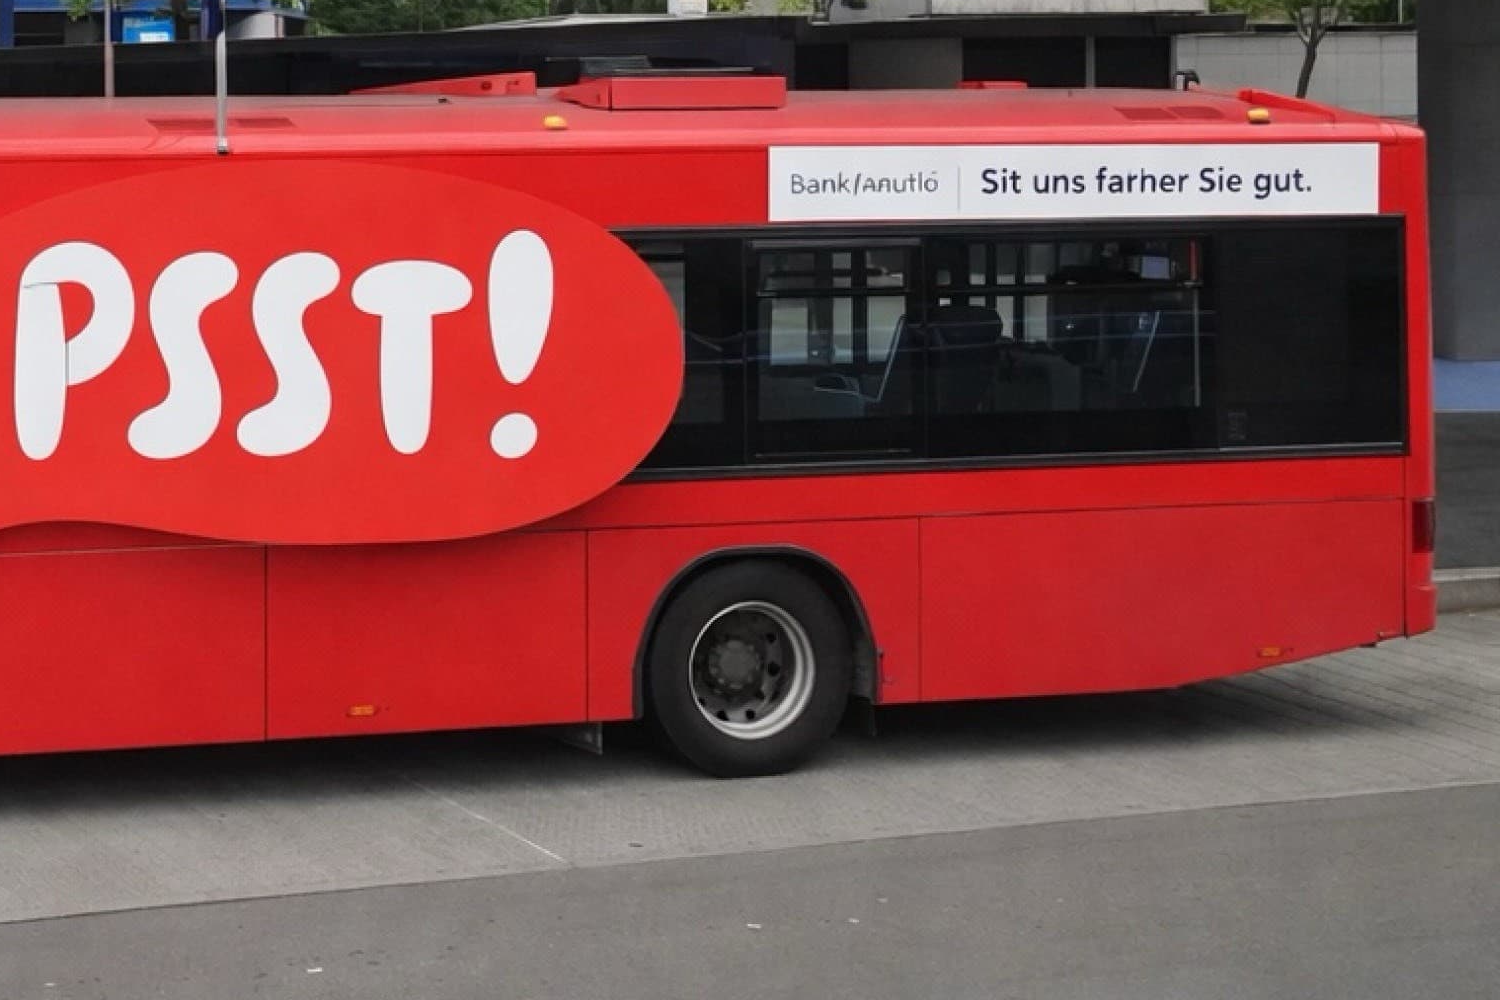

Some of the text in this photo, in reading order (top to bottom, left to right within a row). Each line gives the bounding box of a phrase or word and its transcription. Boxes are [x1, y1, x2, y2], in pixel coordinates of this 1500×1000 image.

[981, 166, 1312, 200] Sit uns farher Sie gut.
[13, 229, 554, 461] PSST!
